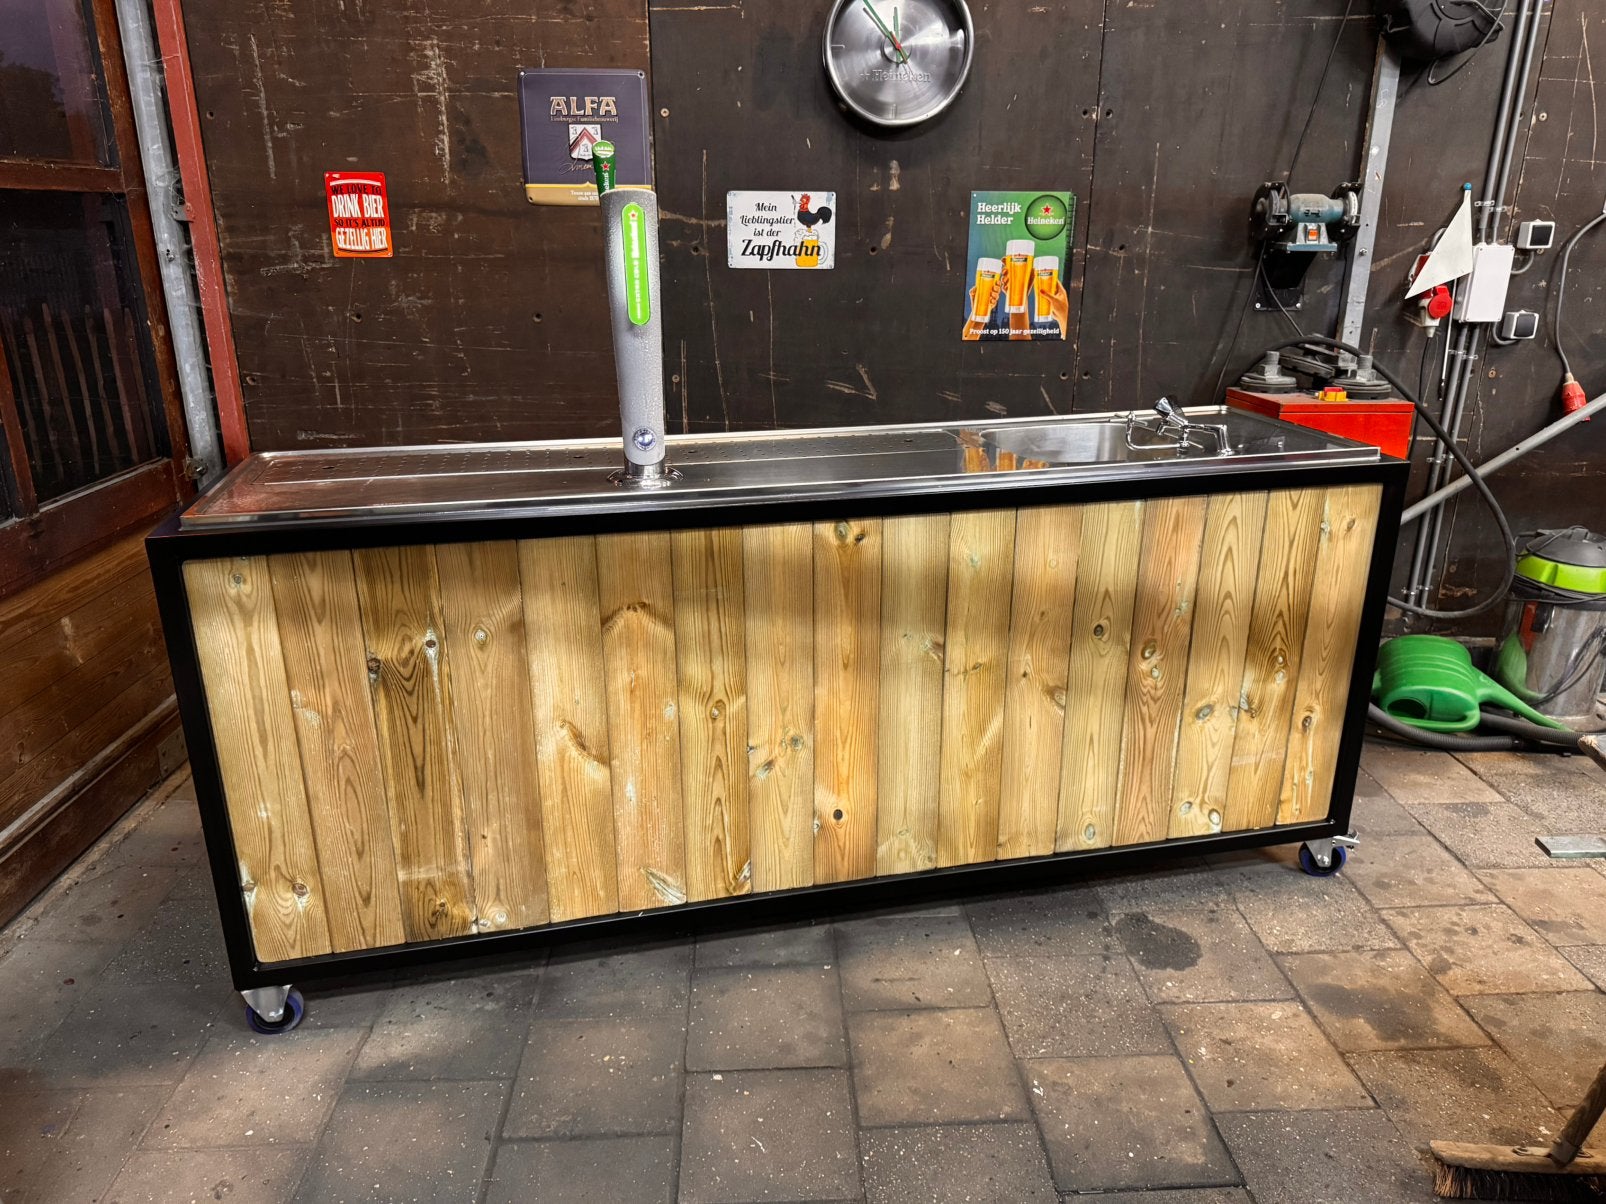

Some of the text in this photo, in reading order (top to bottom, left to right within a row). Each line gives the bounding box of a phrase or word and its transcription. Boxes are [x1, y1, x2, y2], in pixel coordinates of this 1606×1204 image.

[550, 96, 618, 116] ALFA
[332, 185, 345, 194] WE
[347, 184, 367, 194] LOVE
[331, 194, 384, 218] DRINK BIER
[755, 202, 778, 212] Mein
[977, 202, 1021, 214] Heerlijk
[335, 219, 386, 227] SO IT'S ALTIJD
[740, 215, 795, 227] Lieblingstier
[976, 215, 1014, 225] Helder
[1027, 216, 1065, 225] Heineken
[753, 228, 782, 237] ist der
[336, 227, 388, 251] GEZELLIG HIER
[741, 239, 821, 262] Zapfhahn
[1009, 328, 1023, 336] jaar
[1023, 328, 1060, 336] gezelligheid
